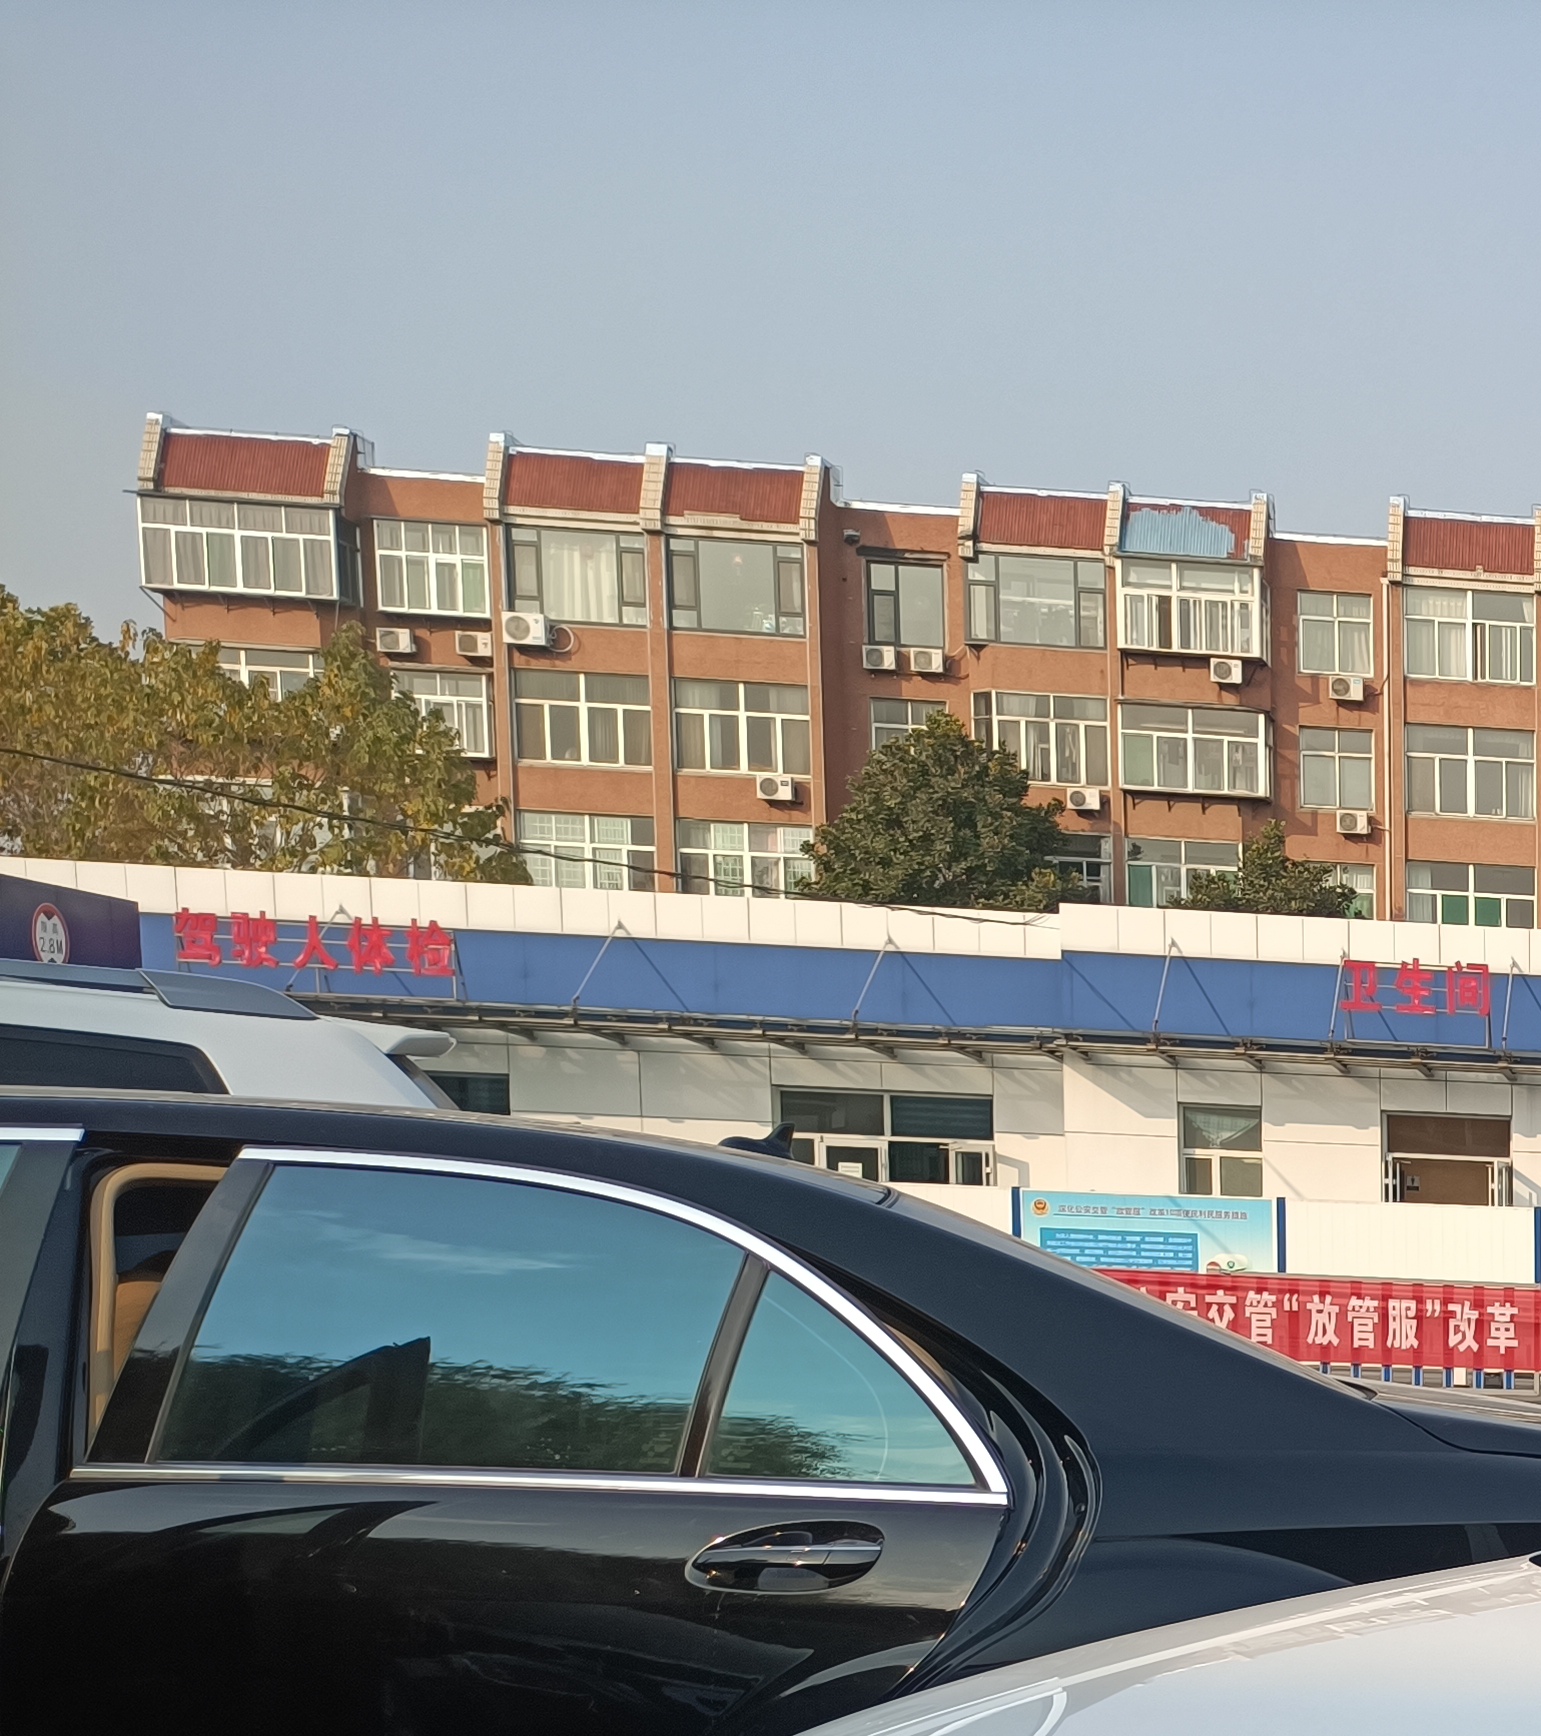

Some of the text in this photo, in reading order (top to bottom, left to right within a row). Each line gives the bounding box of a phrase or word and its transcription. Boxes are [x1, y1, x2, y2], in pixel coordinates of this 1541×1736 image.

[174, 907, 456, 977] 驾驶人体检
[1341, 958, 1490, 1017] 卫生间
